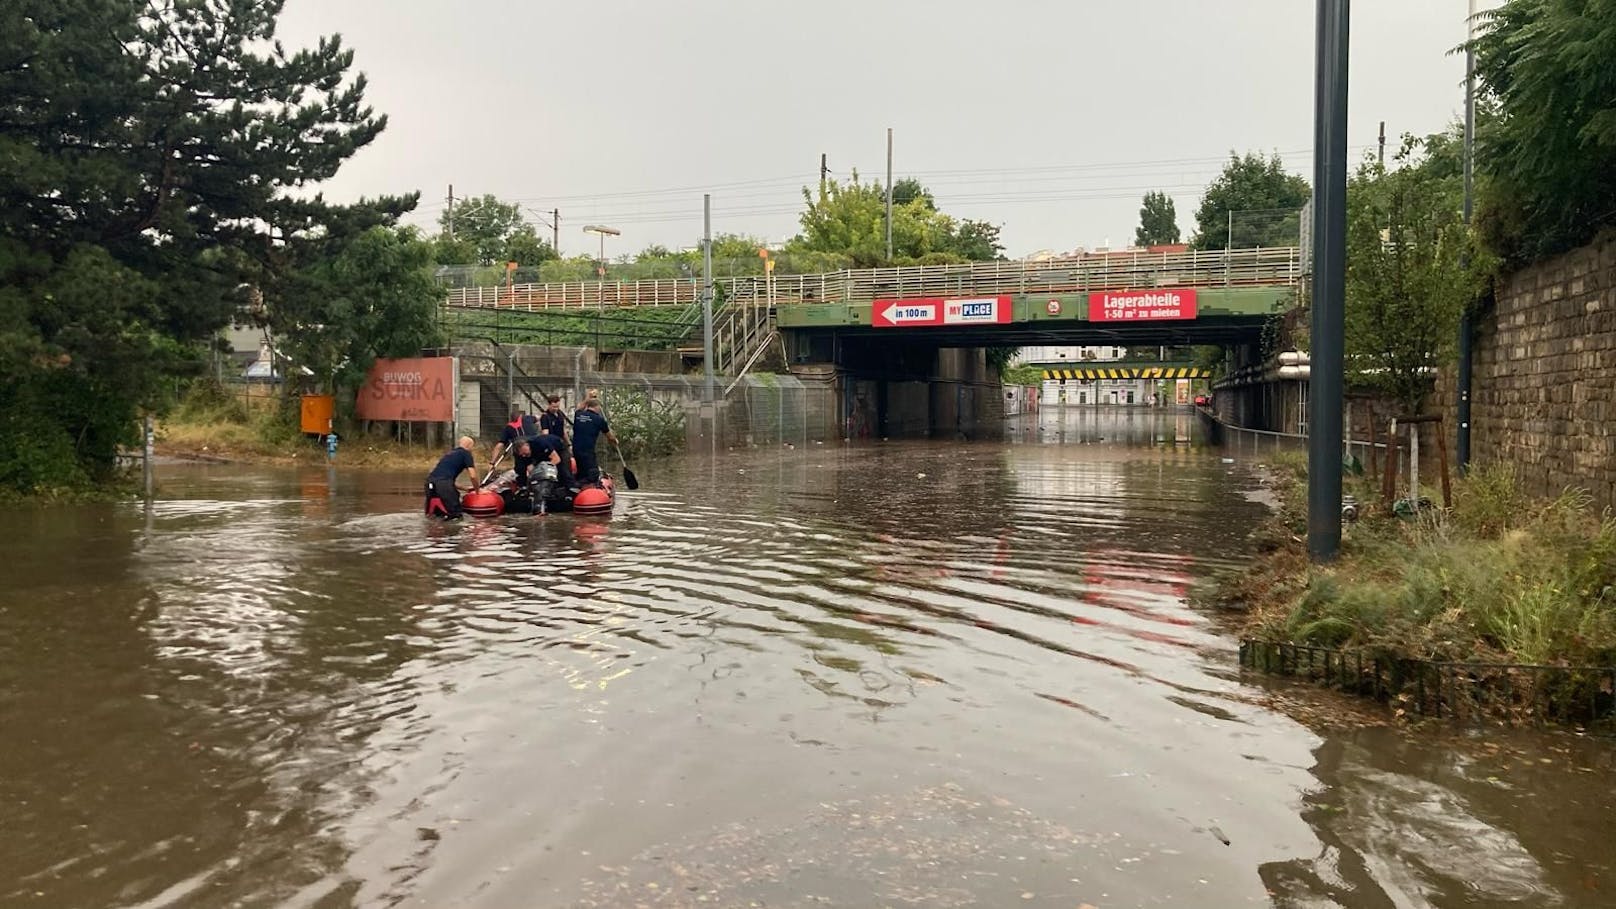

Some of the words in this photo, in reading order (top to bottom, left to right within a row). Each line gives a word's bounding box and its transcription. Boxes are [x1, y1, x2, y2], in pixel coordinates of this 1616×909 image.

[1104, 293, 1180, 309] Lagerabteile
[895, 308, 903, 318] in
[905, 308, 919, 318] 100
[920, 309, 928, 317] m
[1104, 309, 1123, 318] 1-50
[1138, 310, 1148, 318] zu
[1150, 309, 1180, 317] mieten
